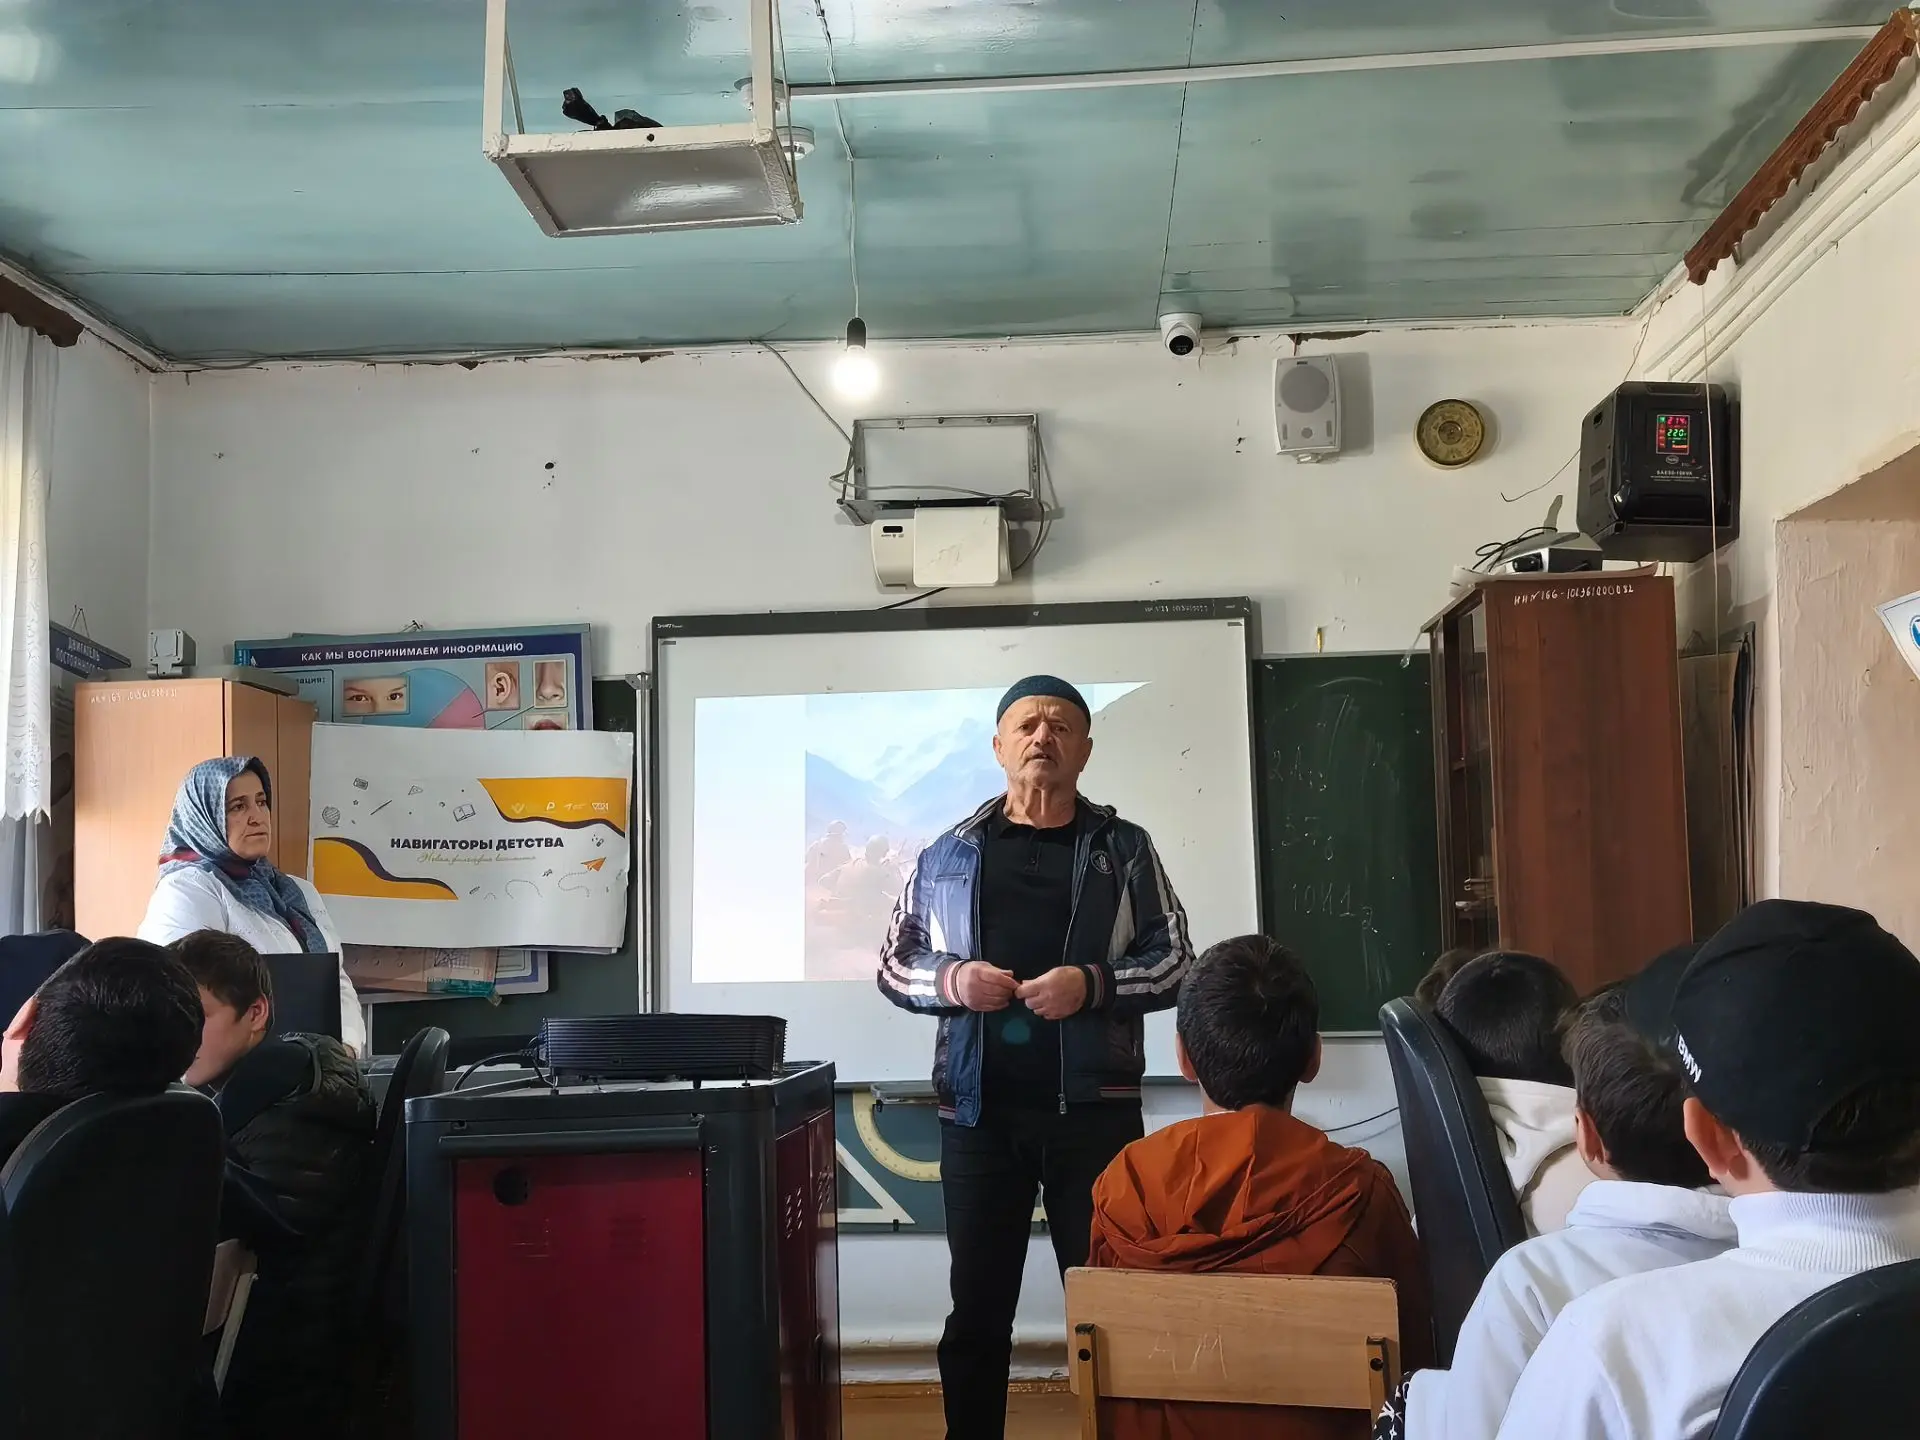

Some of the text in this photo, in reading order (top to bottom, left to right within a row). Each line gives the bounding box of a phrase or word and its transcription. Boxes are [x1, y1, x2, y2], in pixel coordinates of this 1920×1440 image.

[301, 642, 524, 662] КАК МЫ ВОСПРИНИМАЕМ ИНФОРМАЦИЮ
[391, 837, 564, 851] НАВИГАТОРЫ ДЕТСТВА
[1678, 1034, 1702, 1083] BMW
